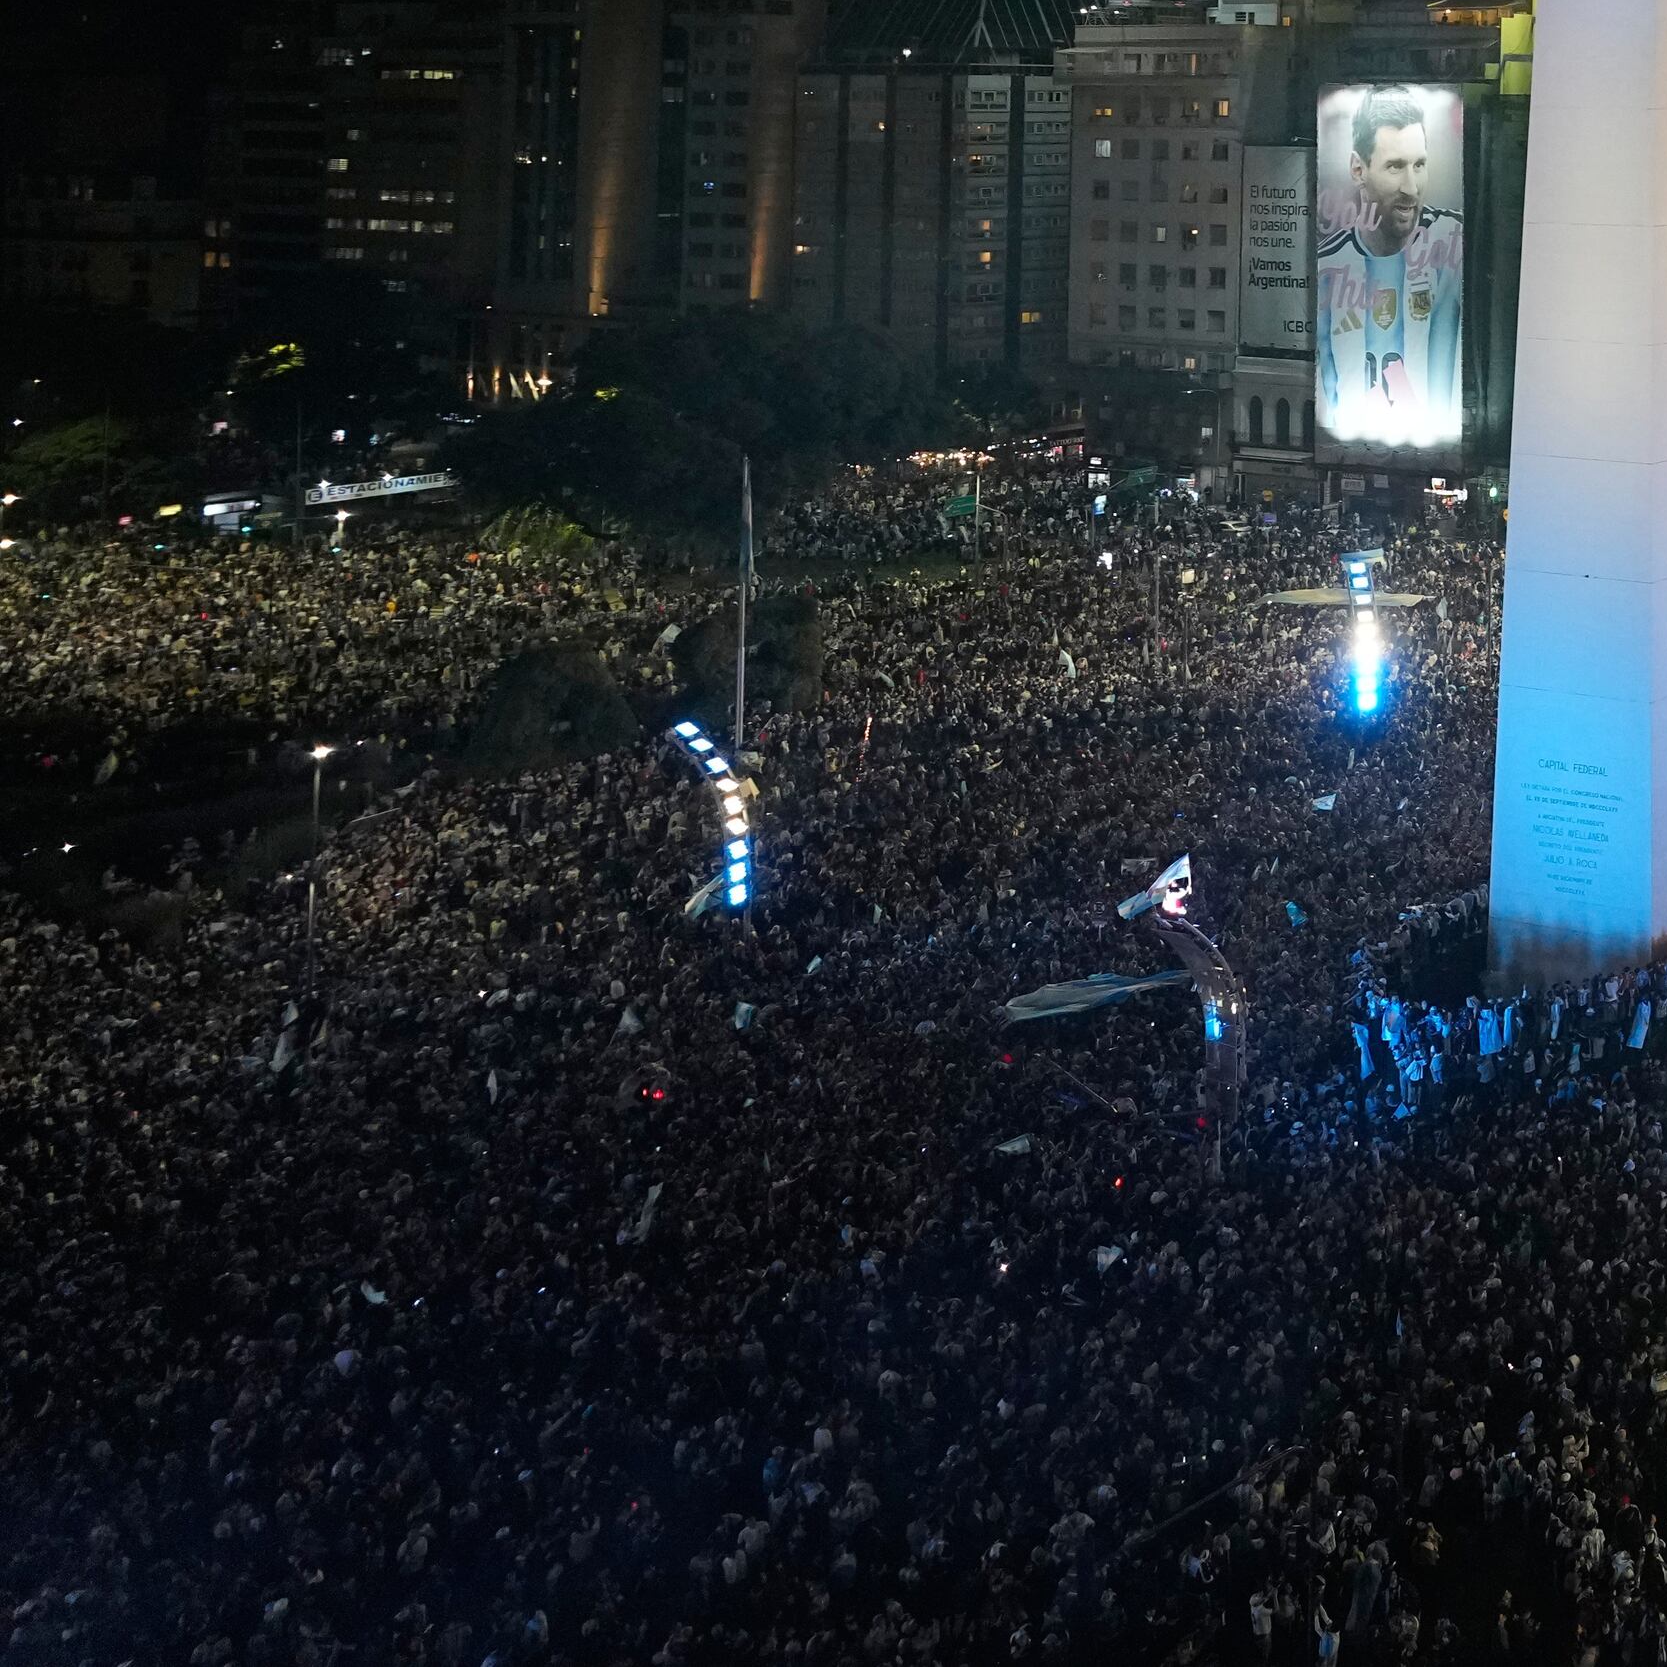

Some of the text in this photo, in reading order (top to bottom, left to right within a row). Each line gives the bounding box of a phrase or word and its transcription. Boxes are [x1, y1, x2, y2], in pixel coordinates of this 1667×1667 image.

[1250, 185, 1296, 199] El futuro
[1249, 204, 1270, 215] nos
[1250, 218, 1297, 234] la pasión
[1249, 237, 1296, 249] nos une.
[1248, 258, 1292, 273] ¡Vamos
[1248, 275, 1310, 290] Argentina!
[1283, 320, 1313, 333] ICBC
[1538, 758, 1609, 777] CAPITAL FEDERAL
[1567, 829, 1609, 842] AVELLANEDA
[1576, 858, 1598, 869] ROCA
